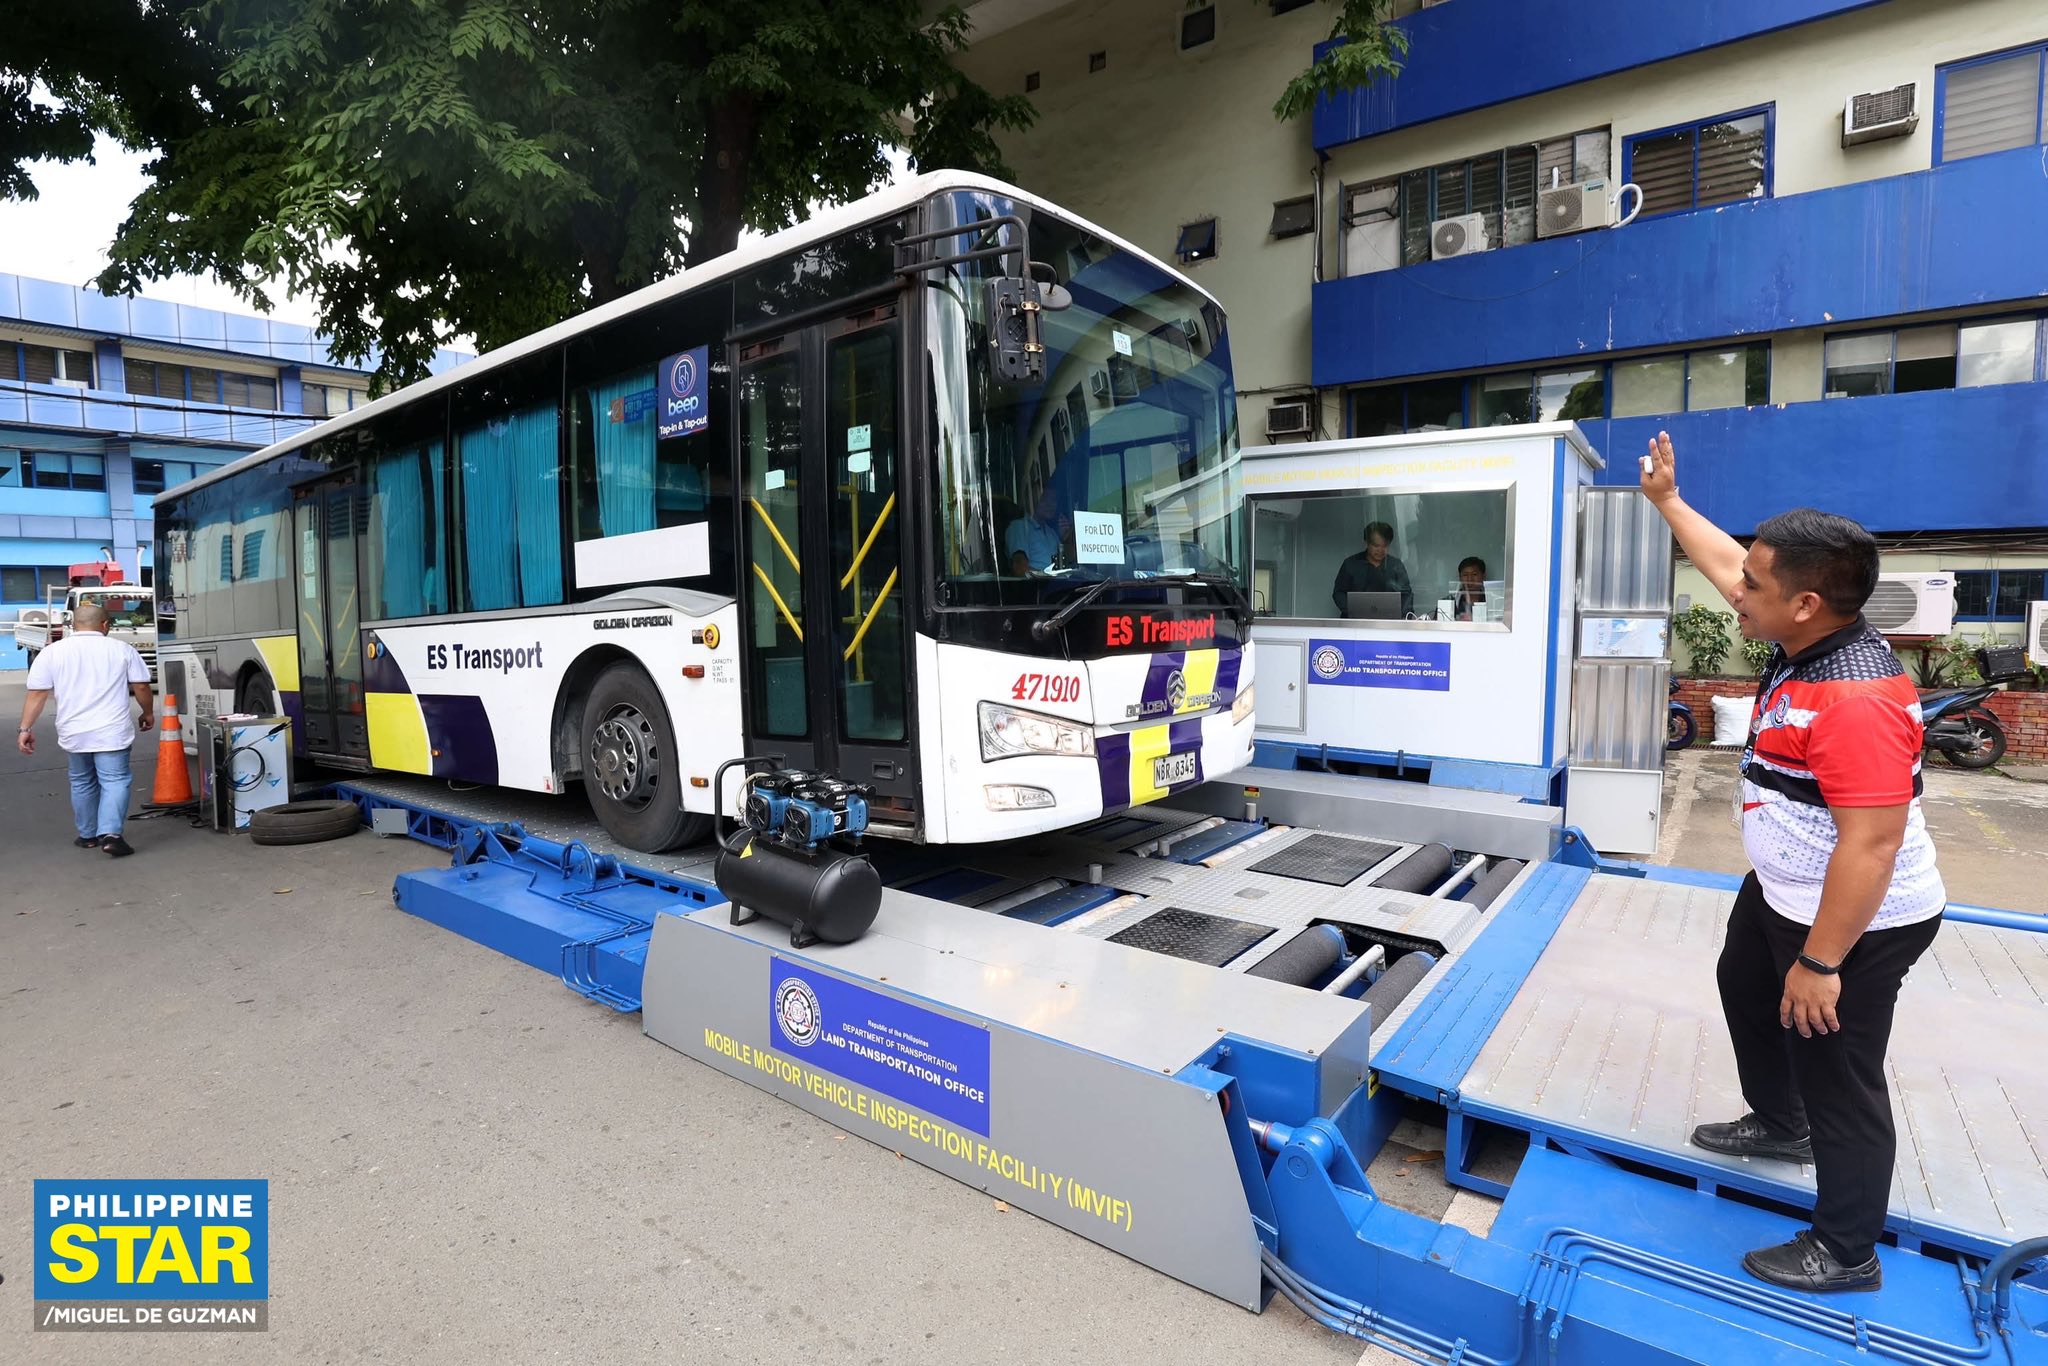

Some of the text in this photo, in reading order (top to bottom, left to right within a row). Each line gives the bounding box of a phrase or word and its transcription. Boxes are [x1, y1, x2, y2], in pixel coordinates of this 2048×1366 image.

[668, 395, 699, 416] beep
[660, 415, 708, 435] Tap-in & Tap-out
[1084, 524, 1114, 536] FOR LTO
[1081, 544, 1120, 554] INSPECTION
[593, 615, 673, 630] GOLDEN DRAGON
[1107, 613, 1215, 646] ES Transport
[427, 641, 543, 675] ES Transport
[1362, 667, 1421, 676] TRANSPORTATION
[1012, 673, 1080, 702] 471910
[1125, 691, 1221, 717] GOLDEN DRAGON
[1156, 758, 1194, 781] NBR 8345
[867, 1020, 929, 1047] Republic of the Philippines
[842, 1023, 958, 1073] DEPARTMENT OF TRANSPORTATION
[821, 1030, 984, 1103] LAND TRANSPORTATION OFFICE
[704, 1028, 751, 1065] MOBILE
[753, 1049, 802, 1088] MOTOR
[804, 1070, 867, 1117] VEHICLE
[871, 1099, 972, 1162] INSPECTION
[1067, 1177, 1133, 1232] (MVIF)
